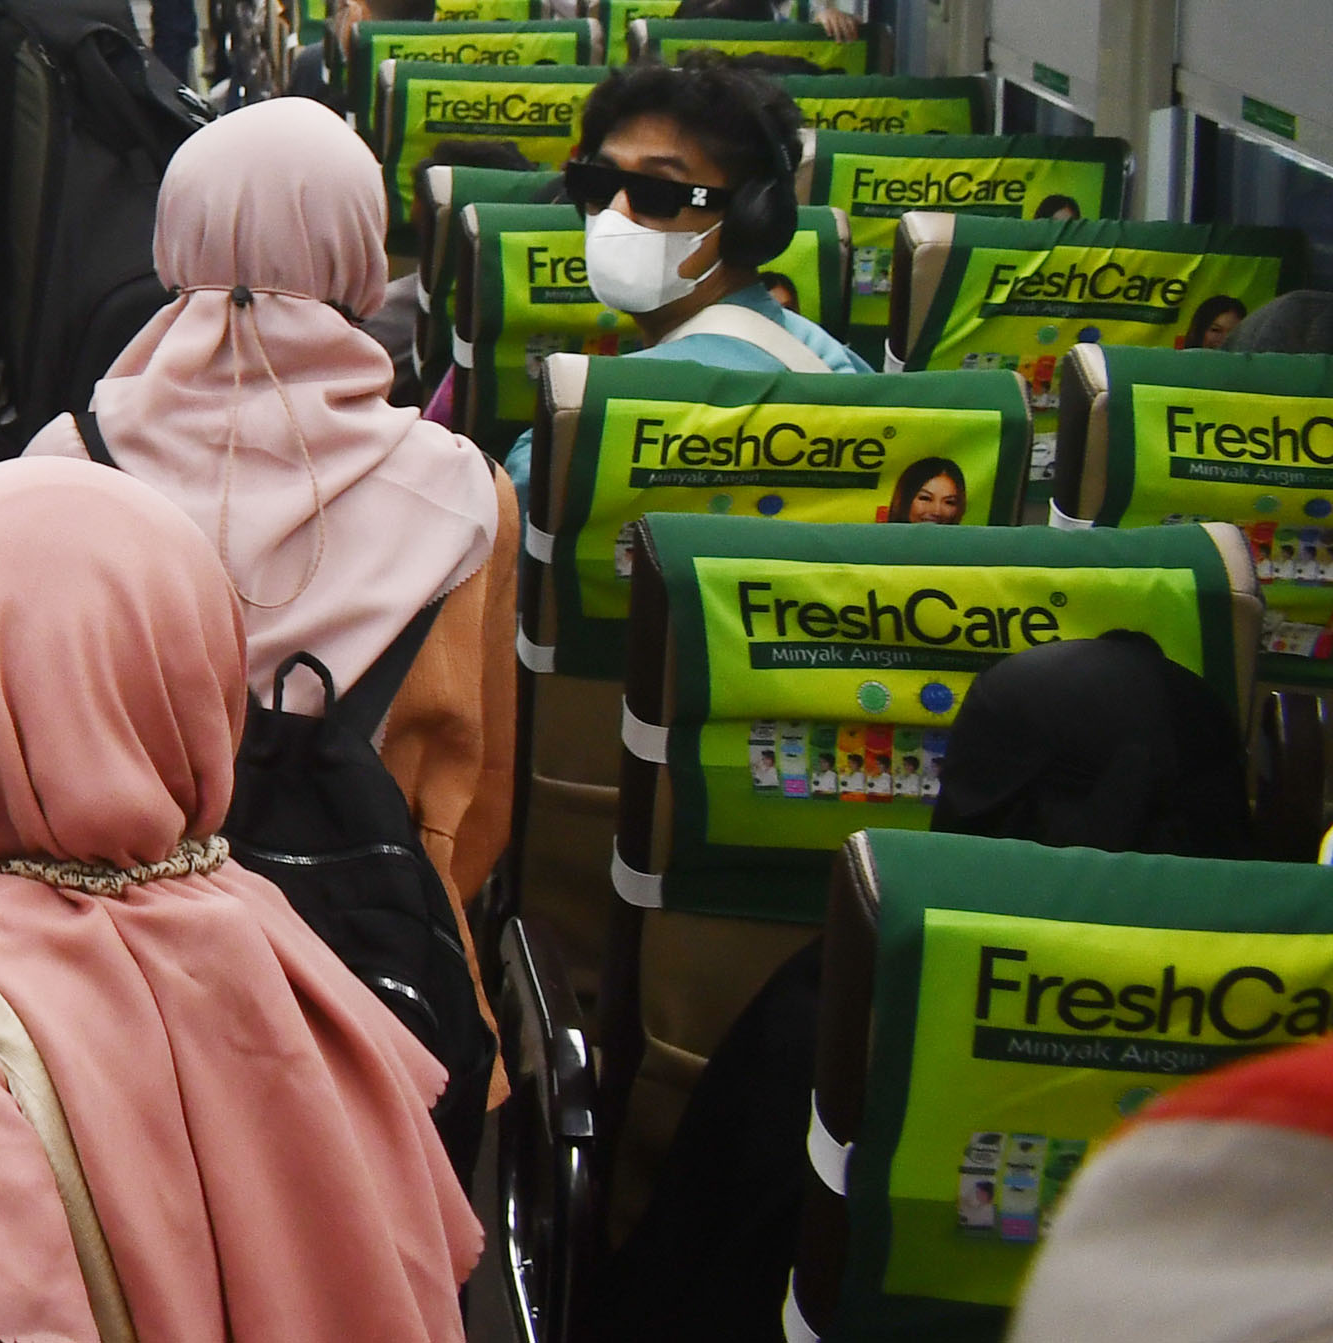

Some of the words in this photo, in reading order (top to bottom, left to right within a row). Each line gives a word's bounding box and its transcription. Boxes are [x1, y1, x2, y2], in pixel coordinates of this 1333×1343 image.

[426, 90, 573, 123] FreshCare
[852, 167, 1026, 203] FreshCare
[984, 261, 1188, 307] FreshCare
[631, 418, 886, 470] FreshCare
[1189, 462, 1249, 480] Minyak
[1254, 466, 1305, 485] Angin
[738, 580, 1061, 649] FreshCare
[771, 645, 844, 667] Minyak
[849, 644, 912, 667] Angin
[1007, 1036, 1111, 1065] Minyak
[1119, 1043, 1207, 1072] Angin
